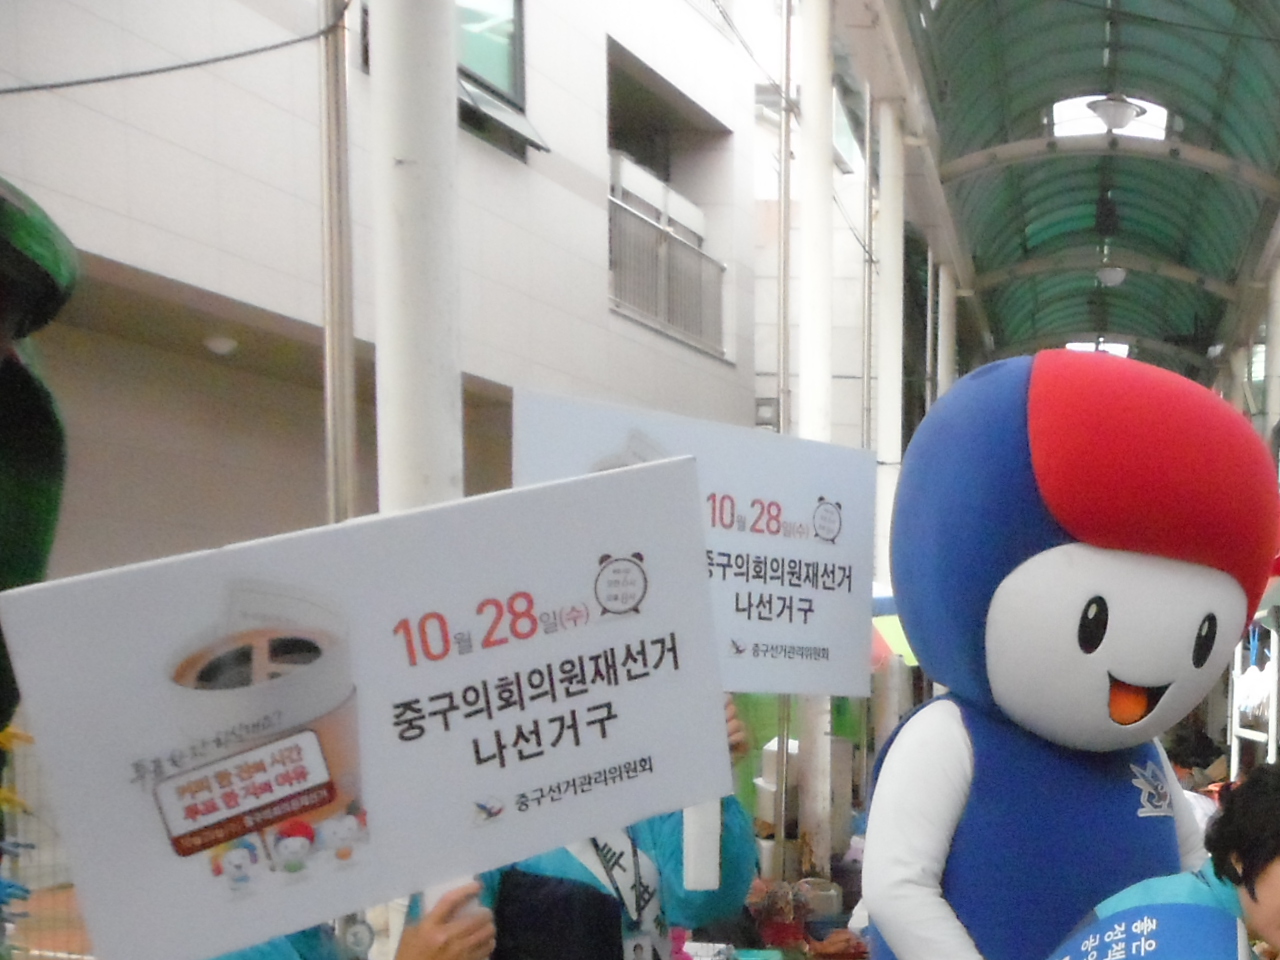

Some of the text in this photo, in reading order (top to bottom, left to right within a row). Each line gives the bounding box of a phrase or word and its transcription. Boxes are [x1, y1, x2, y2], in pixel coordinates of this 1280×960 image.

[707, 493, 746, 532] 10월
[393, 591, 589, 666] 10월 28일(수)
[735, 592, 814, 624] 나선거구
[752, 643, 829, 661] 중구선거관리위원회
[392, 632, 680, 742] 중구의회의원재선거
[472, 702, 618, 768] 나선거구
[515, 756, 653, 812] 중구선거관리위원회
[1132, 916, 1157, 956] 좋은
